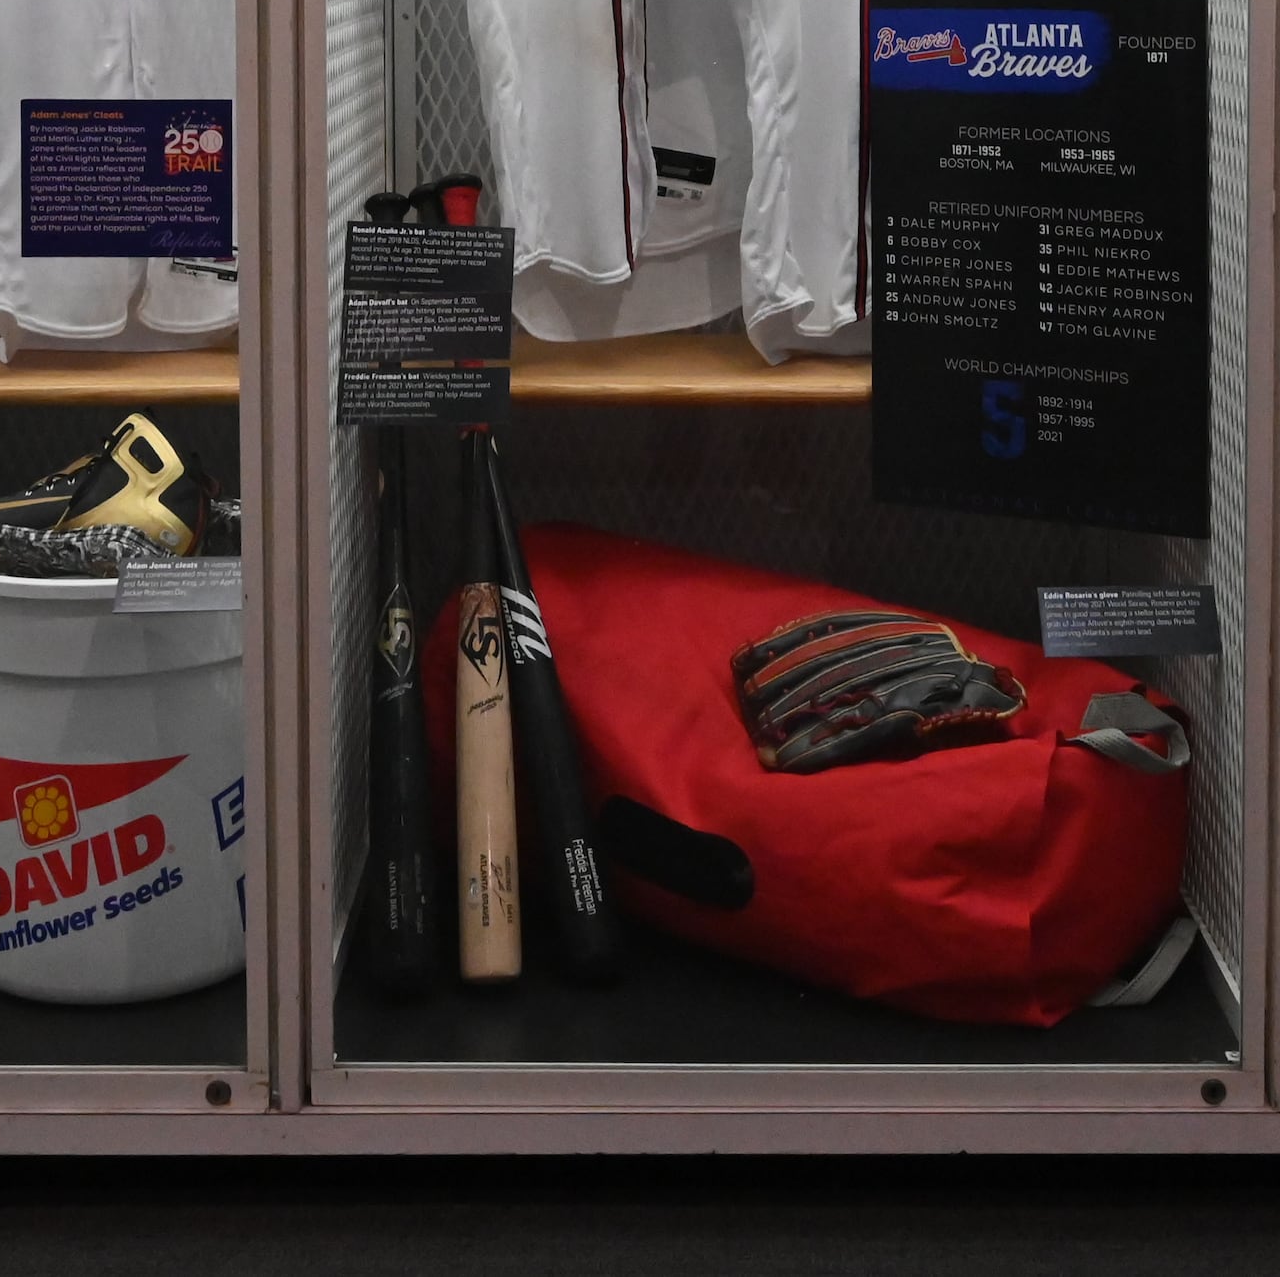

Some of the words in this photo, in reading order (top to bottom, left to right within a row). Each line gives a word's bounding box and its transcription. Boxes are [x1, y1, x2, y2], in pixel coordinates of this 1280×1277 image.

[874, 26, 951, 62] Braves
[985, 23, 1083, 48] ATLANTA
[1118, 35, 1196, 50] FOUNDED
[968, 42, 1092, 78] Braves
[1146, 52, 1168, 63] 1871
[30, 111, 59, 120] Adam
[93, 111, 124, 120] Cleats
[30, 125, 40, 134] By
[42, 125, 78, 134] honoring
[80, 125, 106, 133] Jackie
[108, 125, 145, 133] Robinson
[165, 129, 223, 154] 250
[167, 157, 223, 172] TRAIL
[939, 158, 992, 171] BOSTON,
[995, 160, 1014, 171] MA
[1040, 161, 1116, 177] MILWAUKEE,
[1120, 164, 1135, 176] WI
[929, 201, 991, 216] RETIRED
[994, 204, 1063, 219] UNIFORM
[1067, 208, 1144, 223] NUMBERS
[886, 254, 896, 265] 10
[901, 255, 960, 269] CHIPPER
[966, 259, 1013, 272] JONES
[1039, 283, 1053, 294] 42
[1057, 284, 1107, 298] JACKIE
[1113, 288, 1193, 303] ROBINSON
[1039, 302, 1054, 313] 44
[1057, 304, 1106, 318] HENRY
[1112, 306, 1165, 321] AARON
[344, 373, 370, 381] Freddie
[372, 373, 407, 381] Freeman's
[408, 373, 420, 381] bat
[945, 358, 999, 374] WORLD
[1002, 362, 1129, 384] CHAMPIONSHIPS
[982, 379, 1027, 459] 5
[1038, 430, 1063, 442] 2021
[503, 599, 524, 664] marucci
[480, 854, 488, 892] ATLANTA
[572, 838, 588, 875] Freddie
[580, 874, 597, 915] Freeman
[103, 867, 183, 919] seeds
